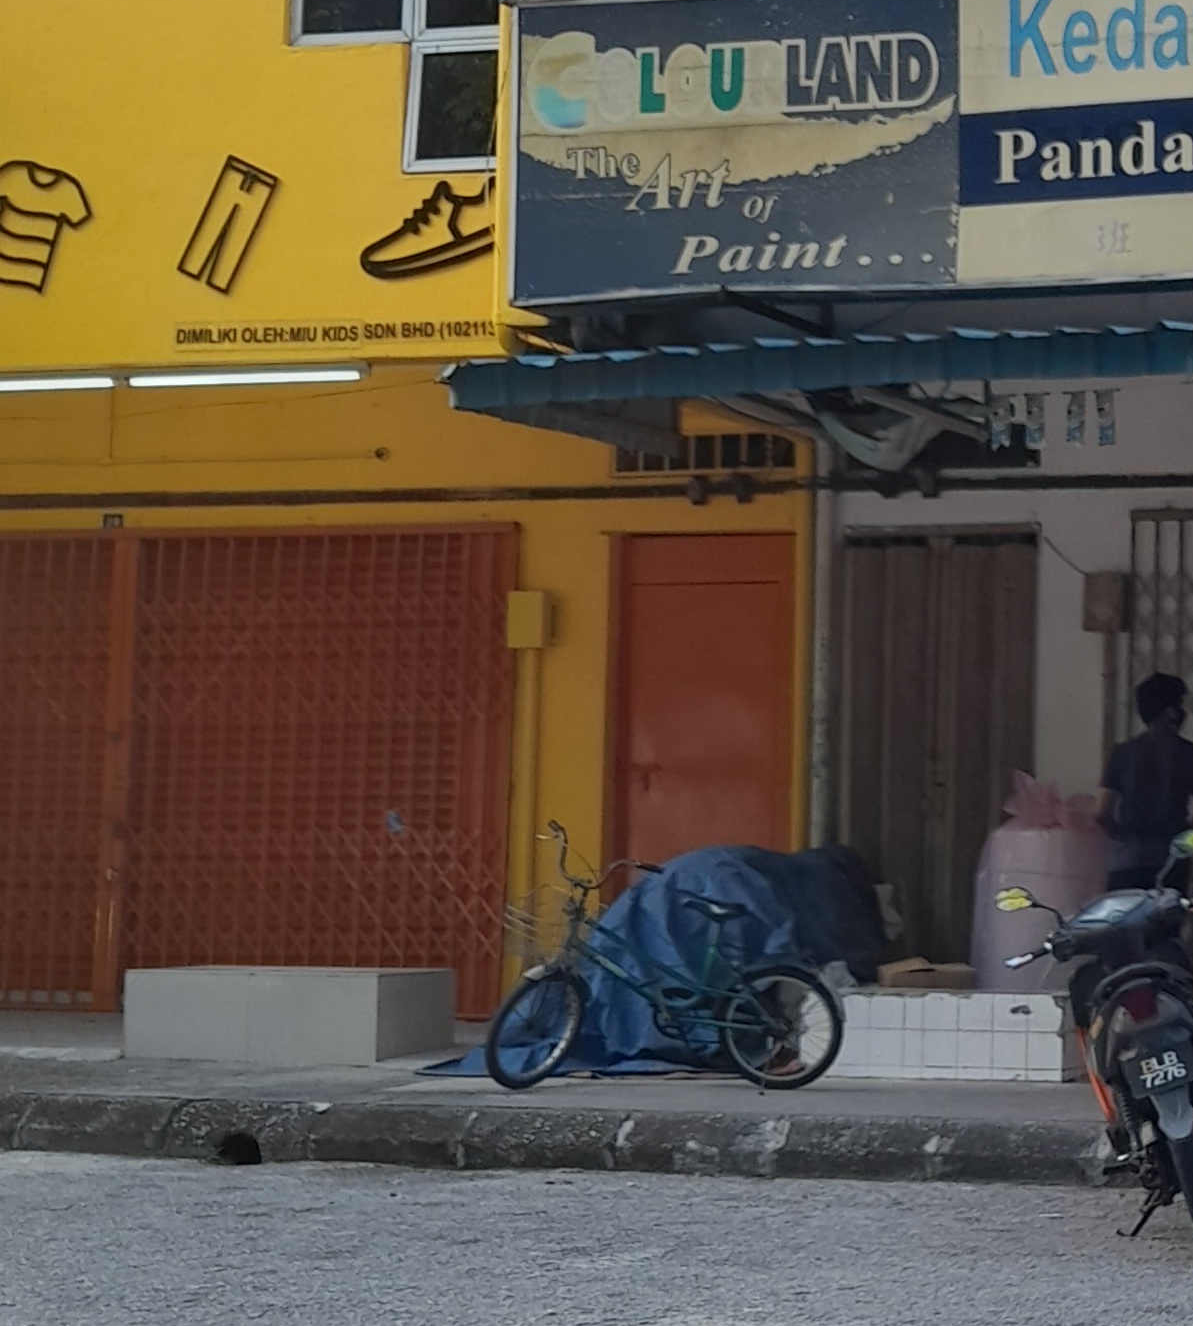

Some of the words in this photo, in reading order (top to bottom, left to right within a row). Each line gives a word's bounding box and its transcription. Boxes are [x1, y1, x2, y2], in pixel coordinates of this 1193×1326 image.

[567, 147, 640, 180] The
[625, 153, 731, 211] Art
[176, 328, 237, 345] DIMILIKI
[321, 325, 358, 342] KIDS
[363, 324, 396, 340] SDN
[401, 323, 436, 339] BHD
[1141, 1051, 1178, 1074] BLB
[1140, 1063, 1186, 1088] 7276
